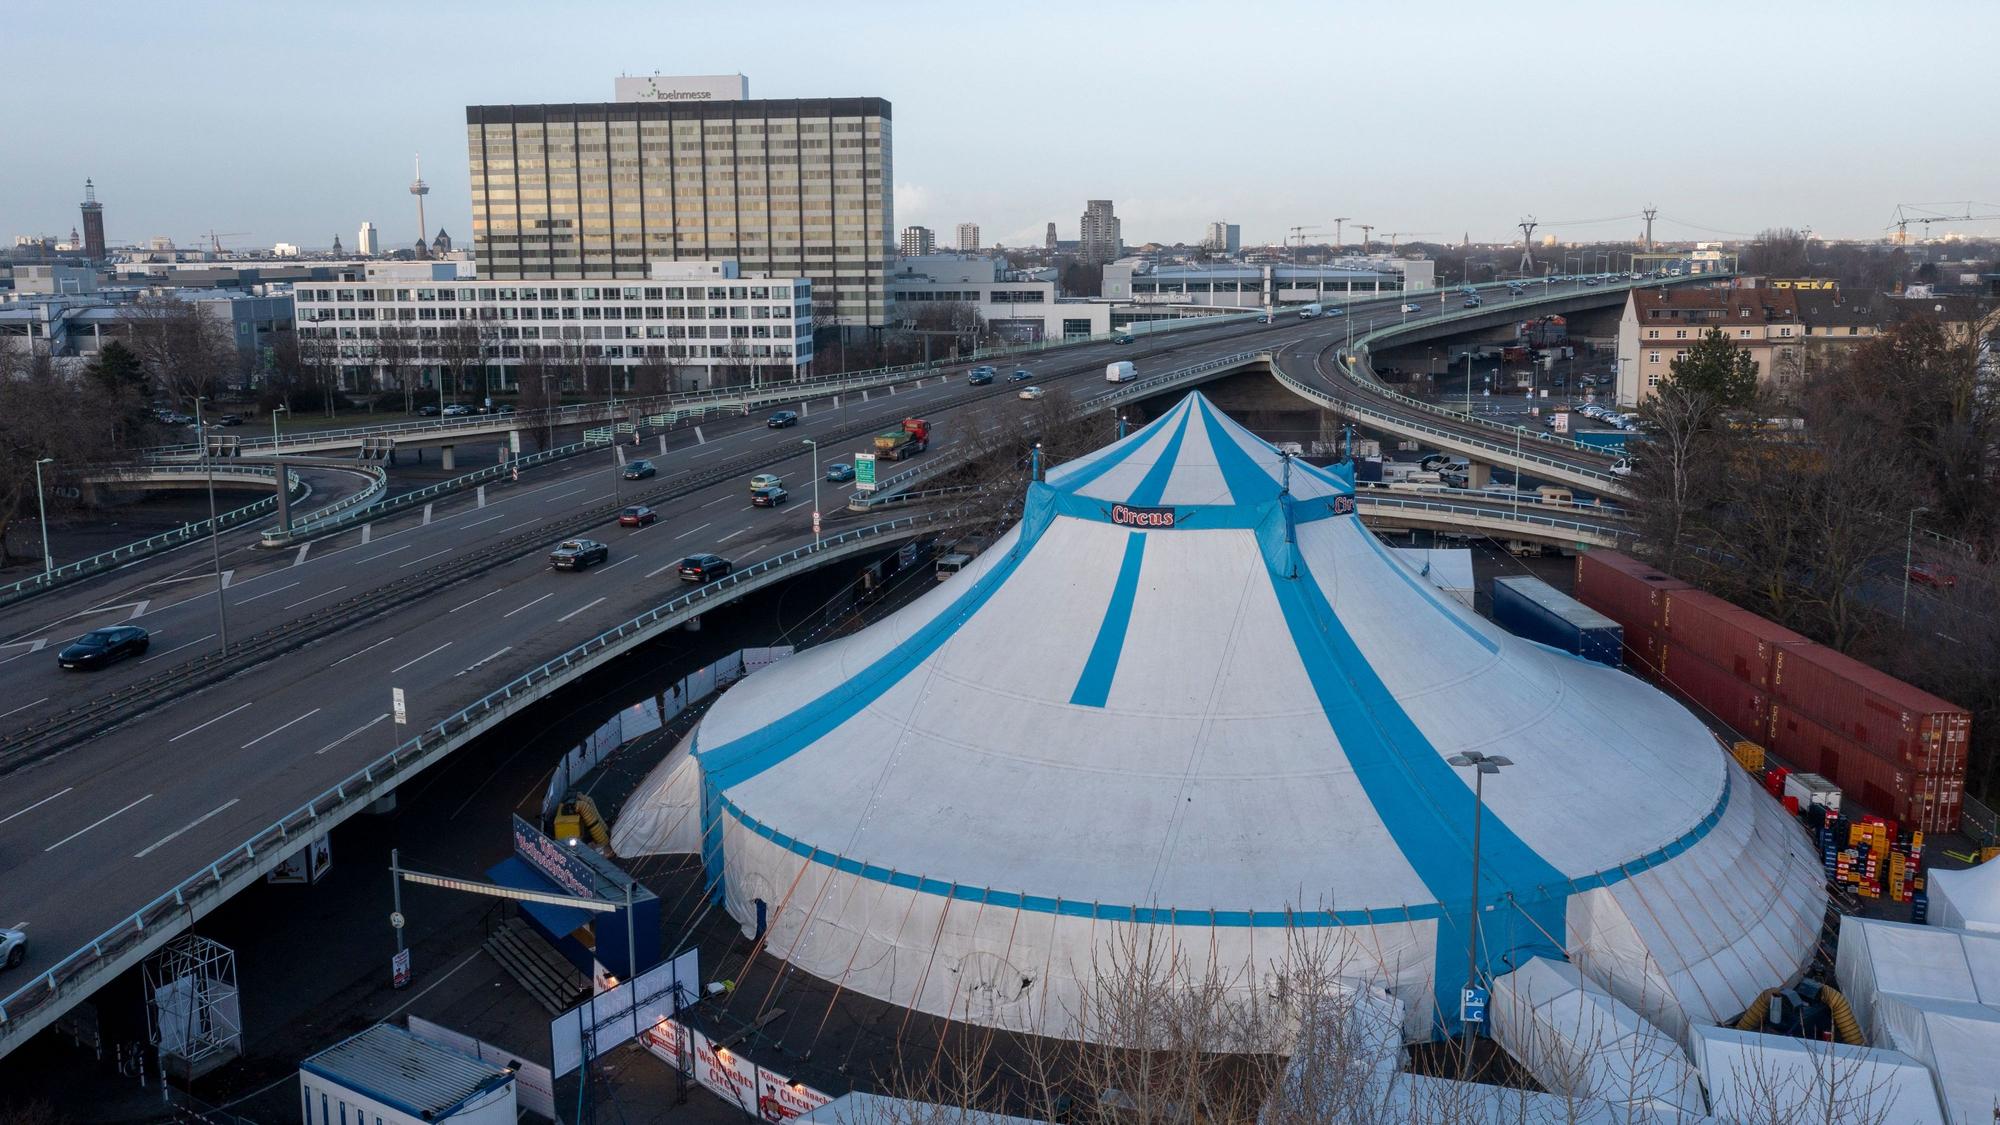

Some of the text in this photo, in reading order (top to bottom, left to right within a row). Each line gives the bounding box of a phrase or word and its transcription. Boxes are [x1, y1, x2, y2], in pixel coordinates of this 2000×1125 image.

[657, 89, 711, 100] koelnmesse
[1112, 504, 1174, 527] Circus
[1473, 1010, 1482, 1020] C
